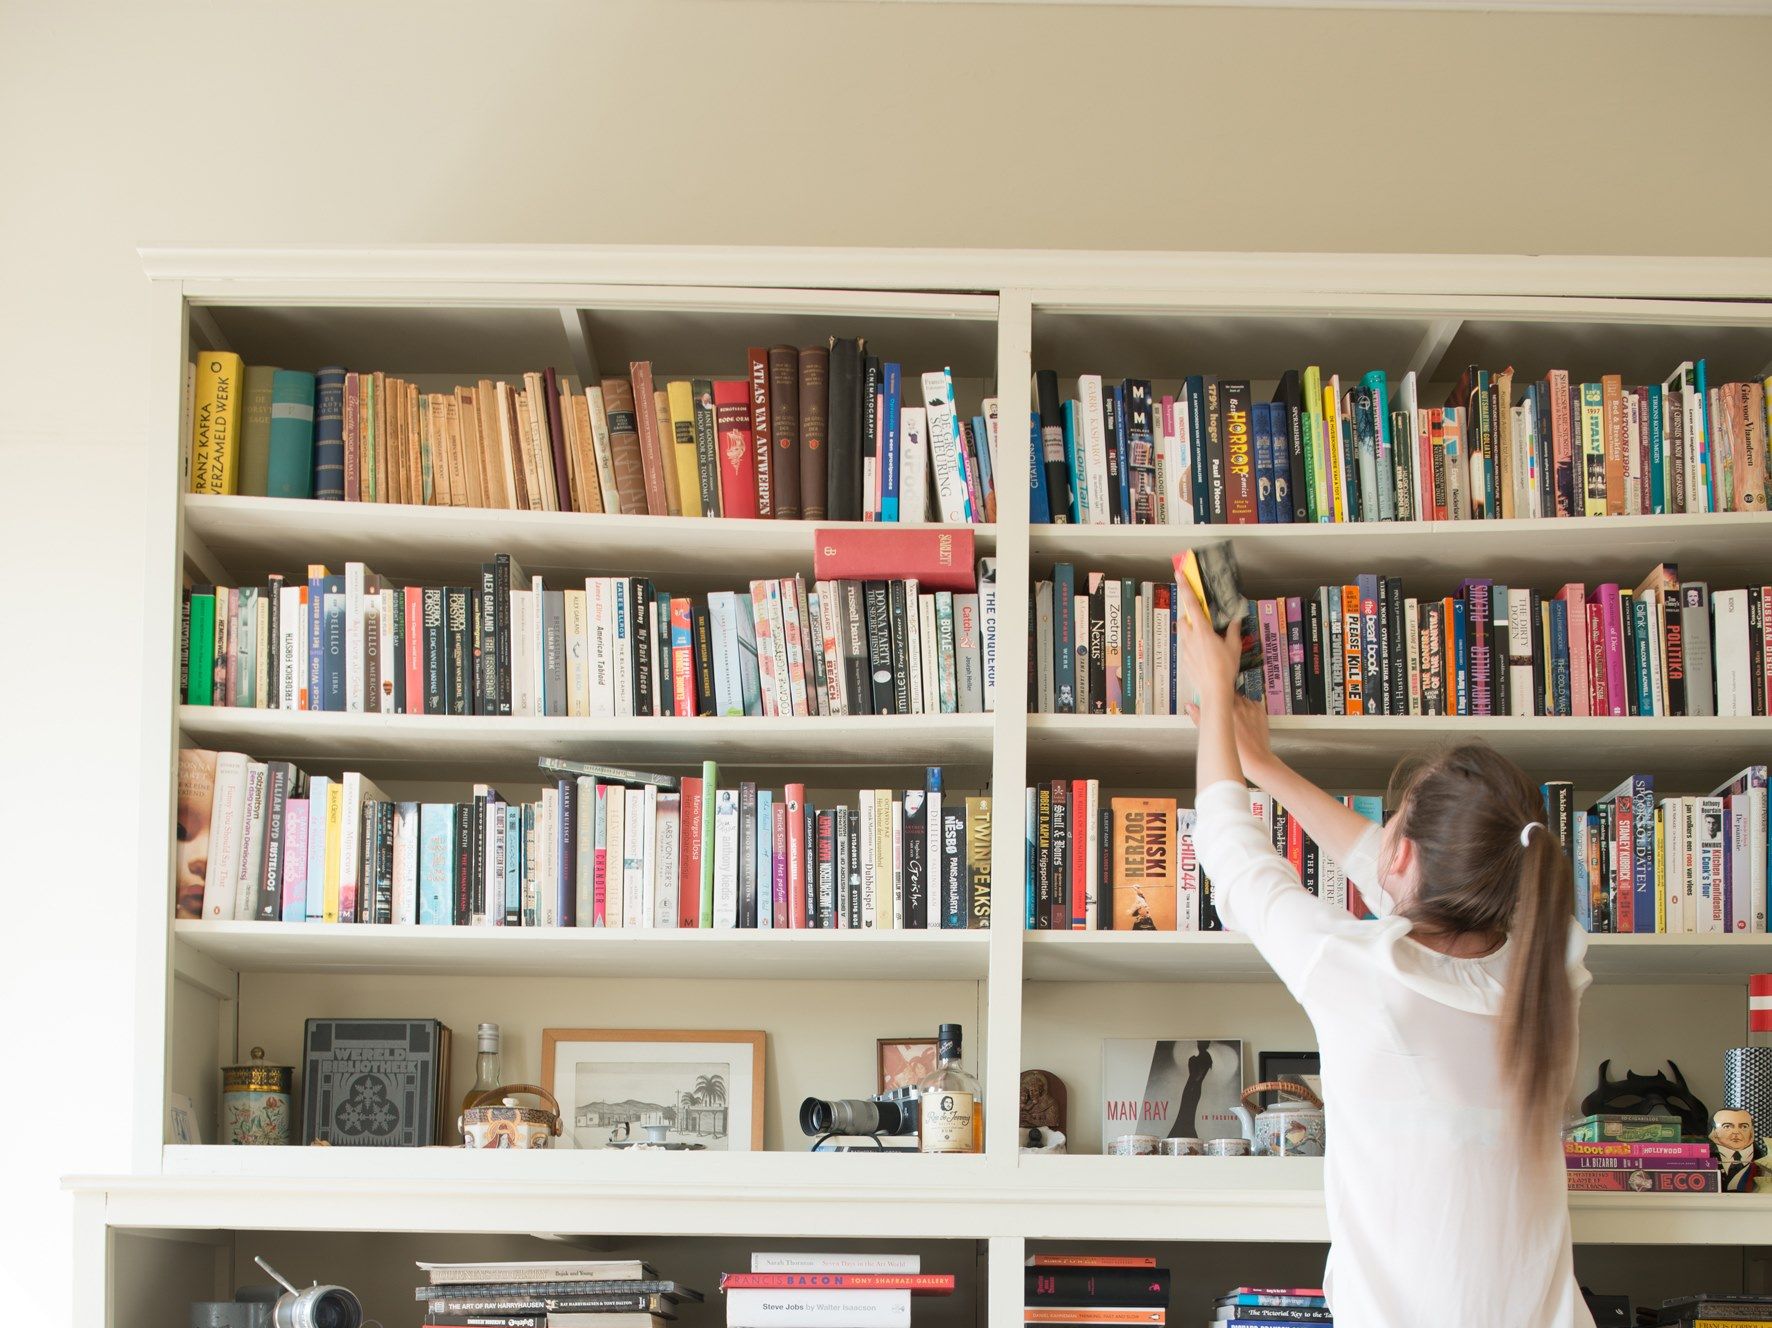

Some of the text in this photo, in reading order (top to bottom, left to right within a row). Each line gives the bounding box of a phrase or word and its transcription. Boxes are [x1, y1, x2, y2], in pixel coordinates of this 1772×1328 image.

[1741, 384, 1750, 404] Gids
[195, 403, 211, 495] FRANZ KAFKA
[211, 377, 229, 495] VERZAMELD WERK
[753, 360, 770, 515] ATLAS VAN ANTWERPEN
[930, 417, 951, 497] SCHEURING
[940, 413, 957, 472] DE GROTE
[1208, 384, 1223, 514] 179% hoger Paul D'Hoore
[1227, 411, 1249, 474] HORROR
[1745, 422, 1754, 466] Vlaanderen
[484, 573, 494, 631] ALEX GARLAND
[847, 586, 860, 655] russell banks
[874, 590, 890, 665] DONNA TARTT
[986, 592, 995, 614] THE
[638, 629, 647, 640] My
[639, 644, 648, 662] Dark
[868, 590, 880, 666] THE SECRET HISTORY
[1091, 619, 1104, 658] Nexus
[1107, 604, 1120, 655] Zoetrope
[1365, 600, 1378, 676] the beat book
[1668, 625, 1682, 679] POLITIKA
[285, 633, 293, 701] FREDERICK FORSYTH
[640, 666, 648, 694] Places
[1348, 616, 1361, 699] PLEASE KILL ME
[956, 819, 963, 830] JO
[1040, 790, 1049, 814] ROBERT
[266, 771, 284, 892] WILLIAM BOYD RUSTELOOS
[945, 816, 956, 854] NESBØ
[1040, 824, 1049, 847] KAPLAN
[1125, 813, 1144, 877] HERZOG
[1146, 813, 1166, 877] KINSKI
[595, 854, 604, 904] CHANDLER
[864, 863, 873, 910] Dubbelspel
[907, 860, 922, 909] Geisha
[974, 813, 990, 916] TWIN PEAKS
[1040, 849, 1049, 900] Krijgspolitiek
[1712, 850, 1721, 921] Kitchen Confidential
[322, 1060, 417, 1073] BIBLIOTHEEK
[334, 1048, 406, 1060] WERELD
[1107, 1100, 1168, 1120] MAN RAY
[1581, 1158, 1618, 1168] L.A. BIZARRO
[1660, 1174, 1705, 1189] ECO
[728, 1277, 783, 1285] FRANCIS
[787, 1276, 844, 1285] BACON
[762, 1303, 784, 1311] Steve
[785, 1303, 804, 1311] Jobs
[806, 1304, 815, 1312] by
